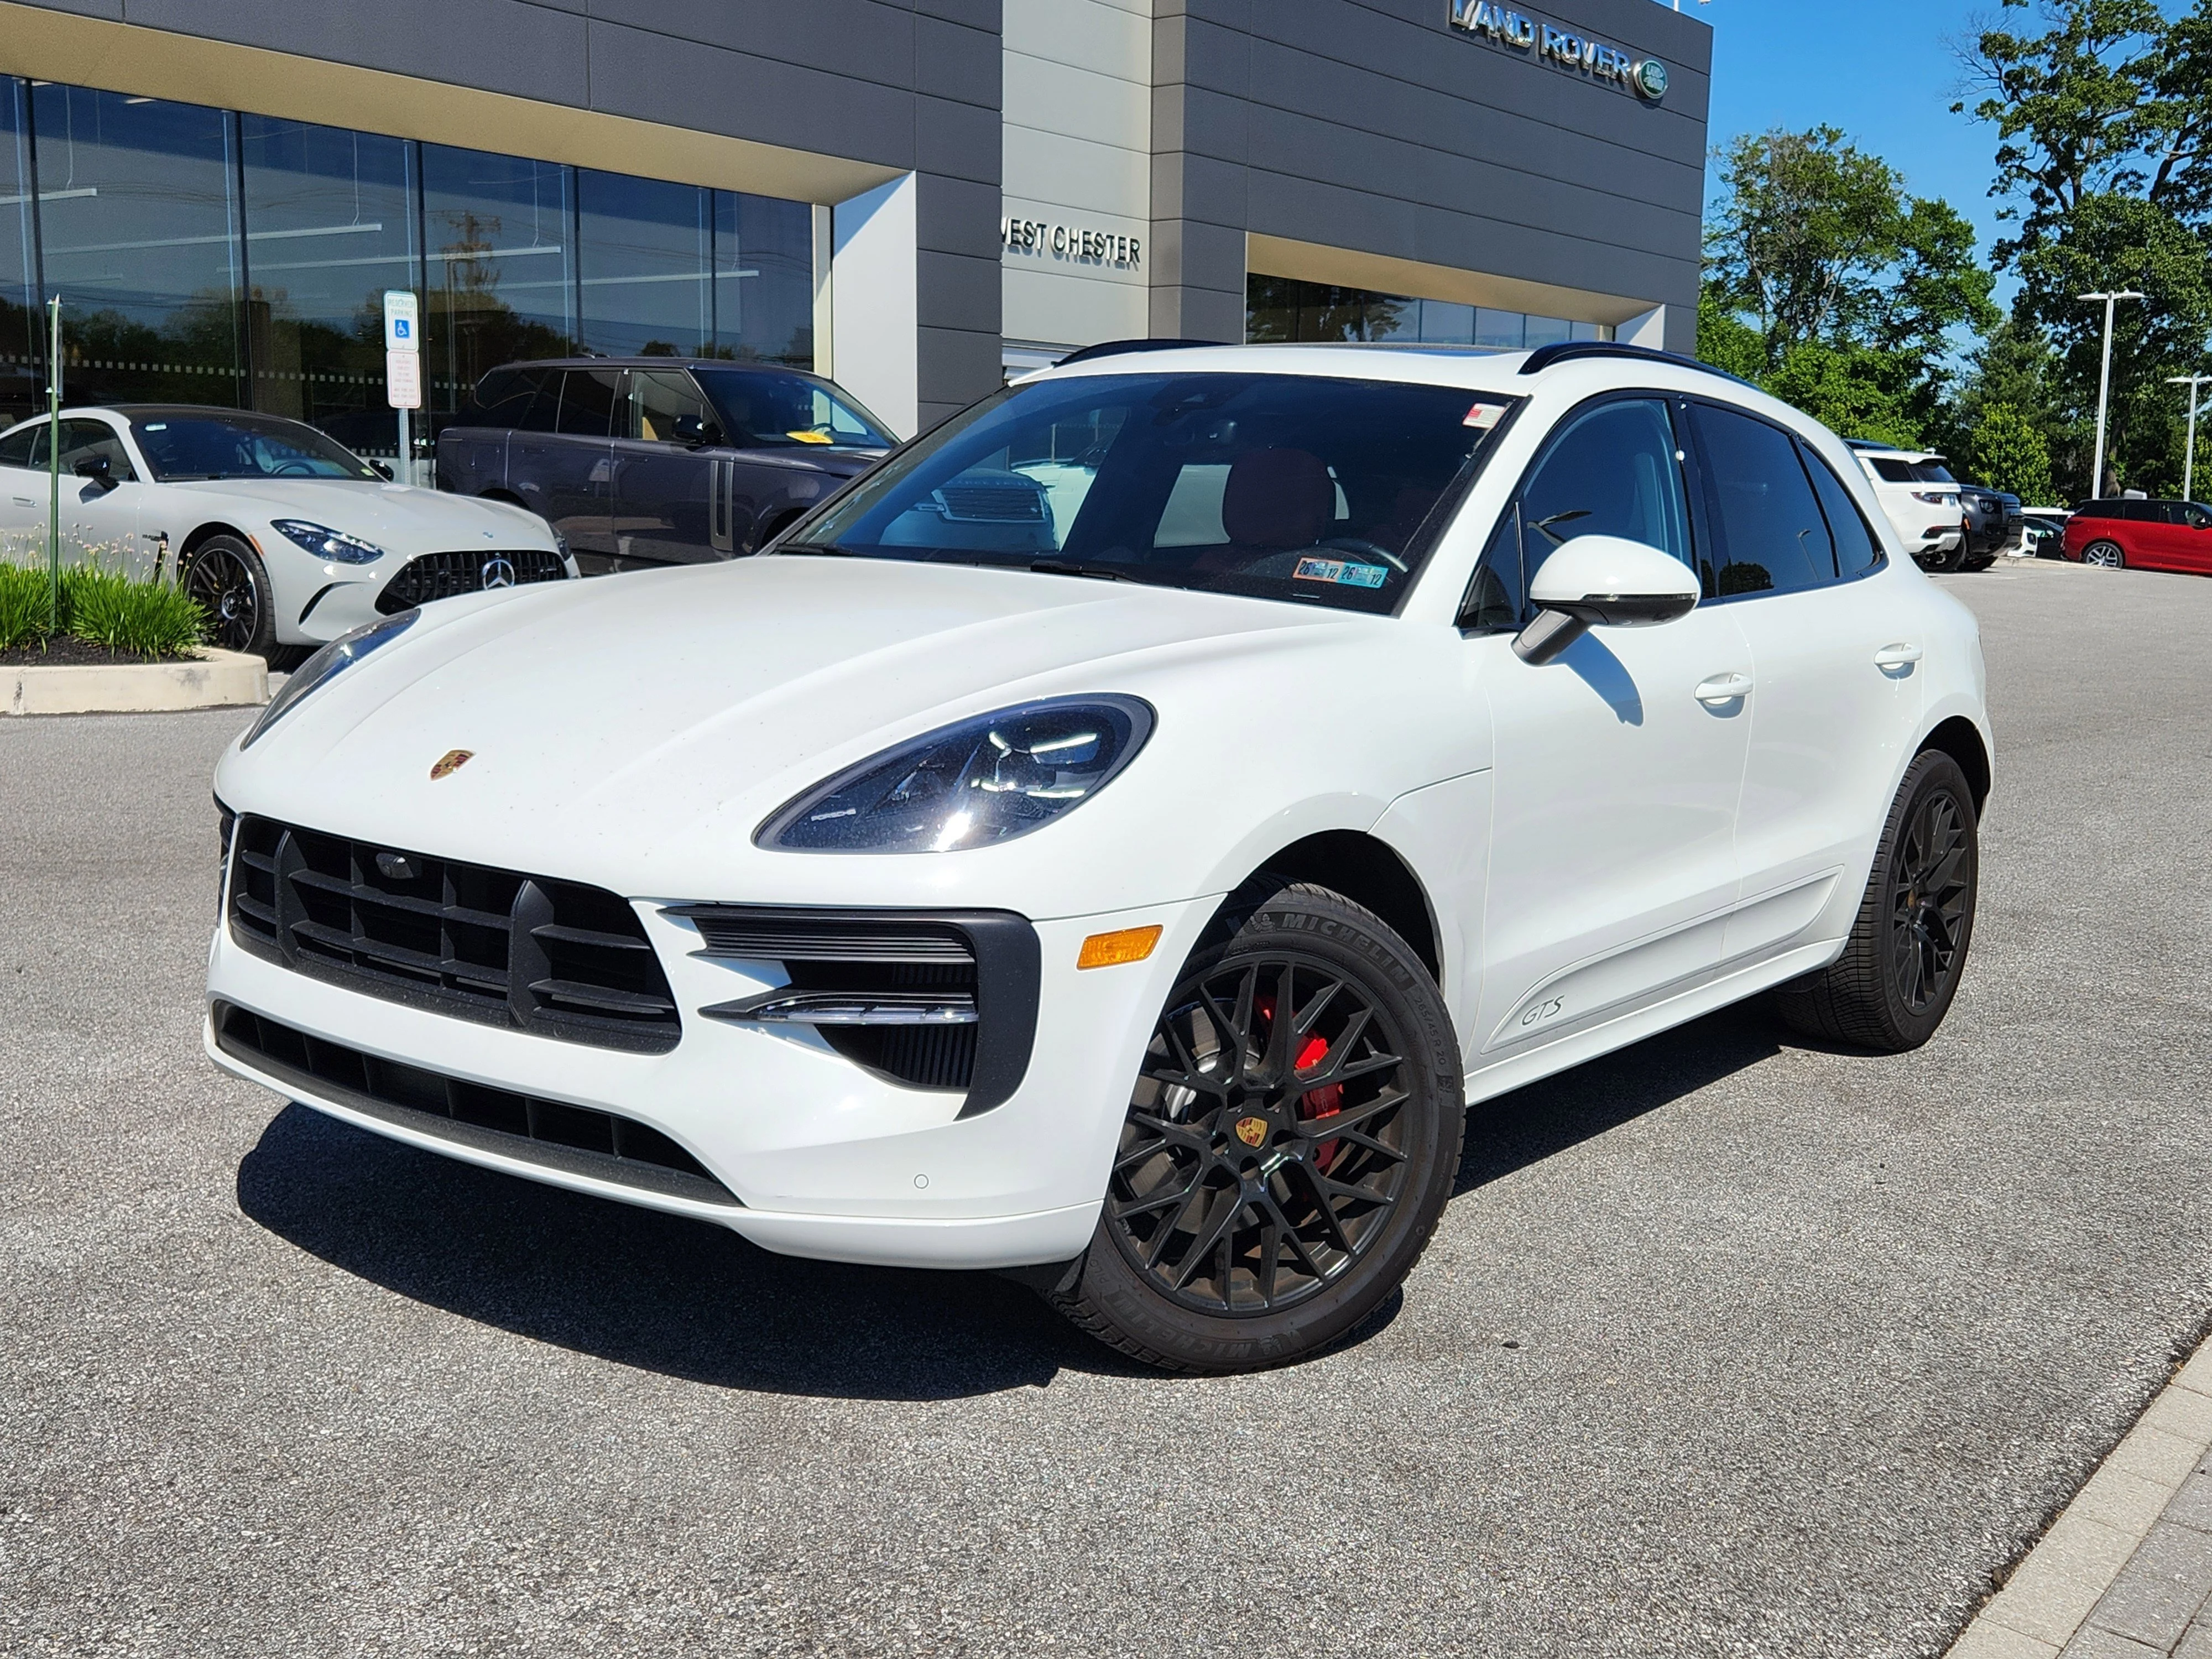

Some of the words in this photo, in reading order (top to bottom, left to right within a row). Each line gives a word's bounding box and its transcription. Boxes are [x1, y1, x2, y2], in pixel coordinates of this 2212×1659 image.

[1449, 0, 1535, 48] LAND
[1540, 23, 1630, 84] ROVER
[1050, 226, 1140, 263] CHESTER
[1327, 567, 1339, 579] 12
[1341, 566, 1355, 580] 26
[1369, 573, 1382, 586] 12
[1281, 913, 1411, 985] MICHELIN
[1522, 995, 1565, 1026] GTS
[1437, 1051, 1446, 1065] 20
[1114, 1296, 1252, 1358] MICHELIN
